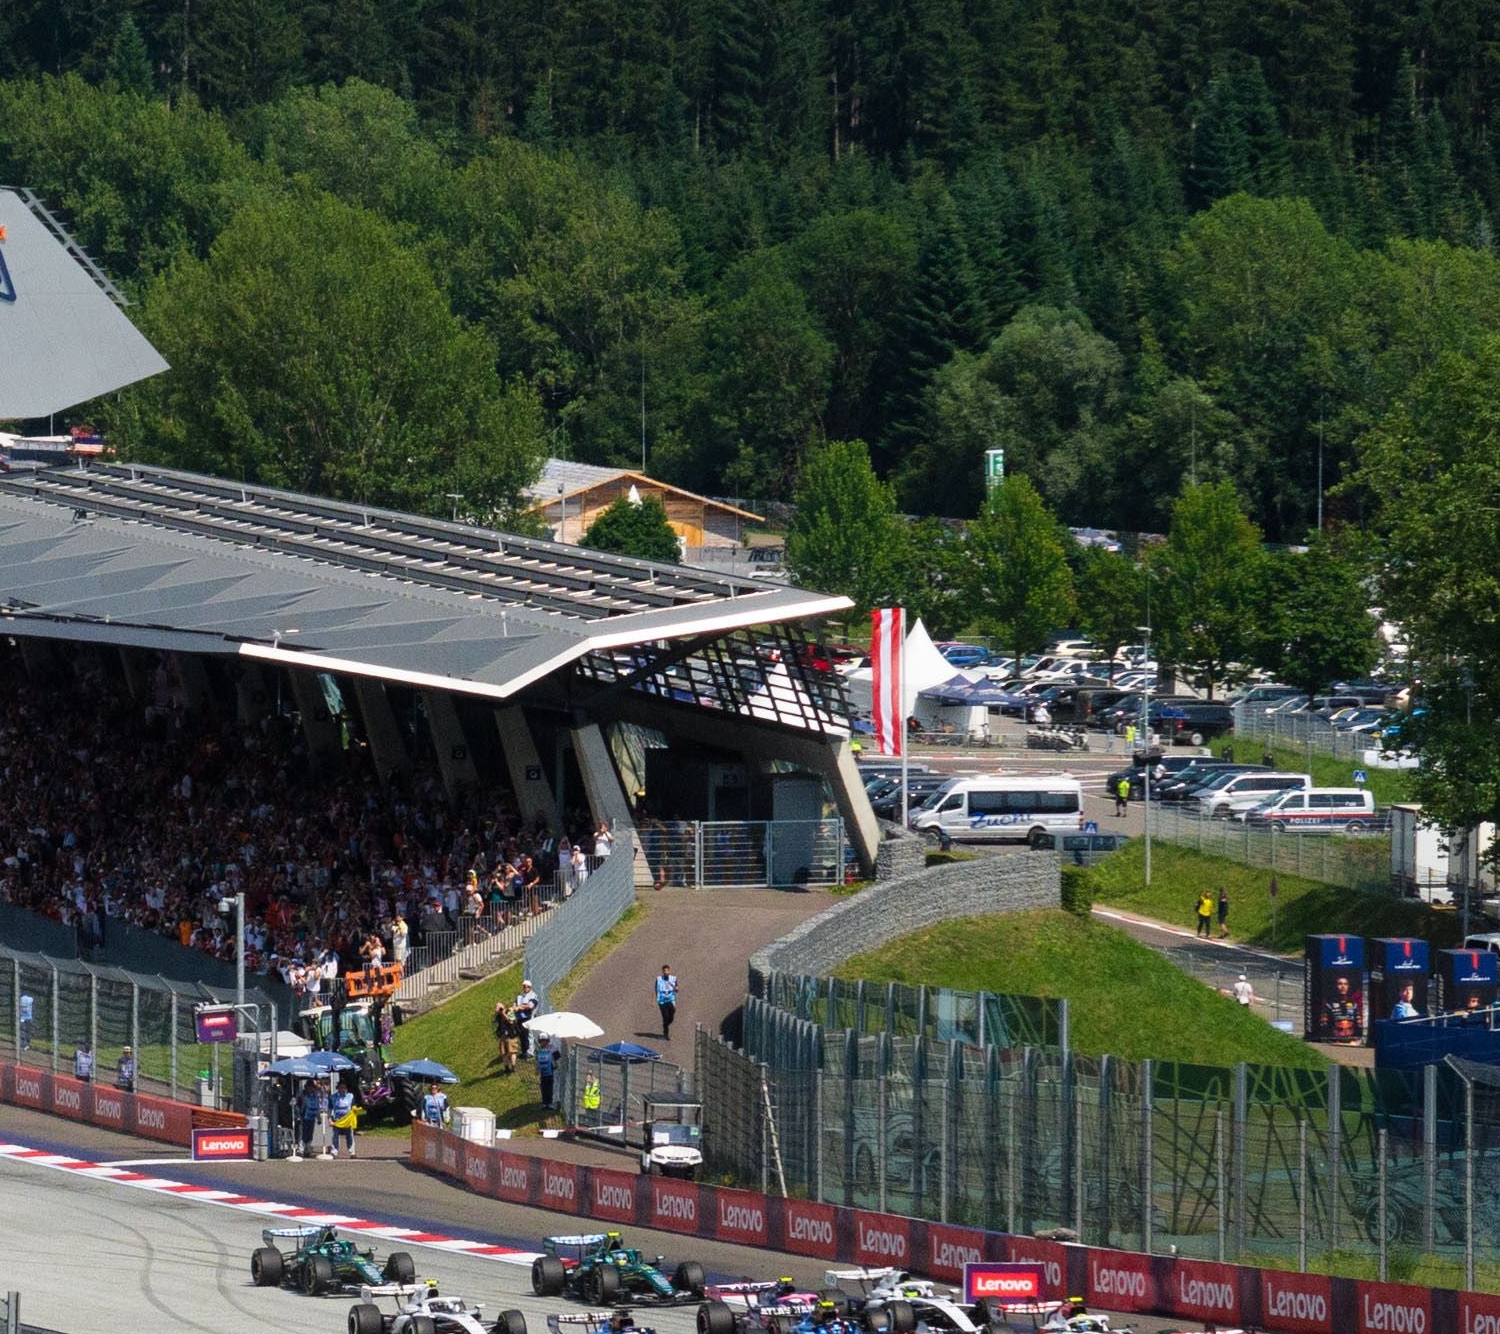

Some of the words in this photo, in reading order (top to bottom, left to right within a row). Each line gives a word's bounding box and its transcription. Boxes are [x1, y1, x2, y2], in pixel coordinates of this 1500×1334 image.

[16, 1076, 40, 1099] Lenovo
[54, 1086, 80, 1109] Lenovo
[95, 1095, 121, 1119] Lenovo
[138, 1107, 164, 1129] Lenovo
[202, 1138, 244, 1151] Lenovo
[501, 1163, 527, 1190] Lenovo
[544, 1171, 574, 1199] Lenovo
[597, 1182, 631, 1210] Lenovo
[656, 1192, 695, 1220] Lenovo
[722, 1203, 762, 1231] Lenovo
[788, 1213, 831, 1243] Lenovo
[860, 1222, 905, 1257] Lenovo
[977, 1278, 1032, 1291] Lenovo
[1094, 1261, 1145, 1296] Lenovo
[1180, 1272, 1232, 1309] Lenovo
[1268, 1282, 1326, 1321] Lenovo
[1364, 1294, 1426, 1334] Lenovo
